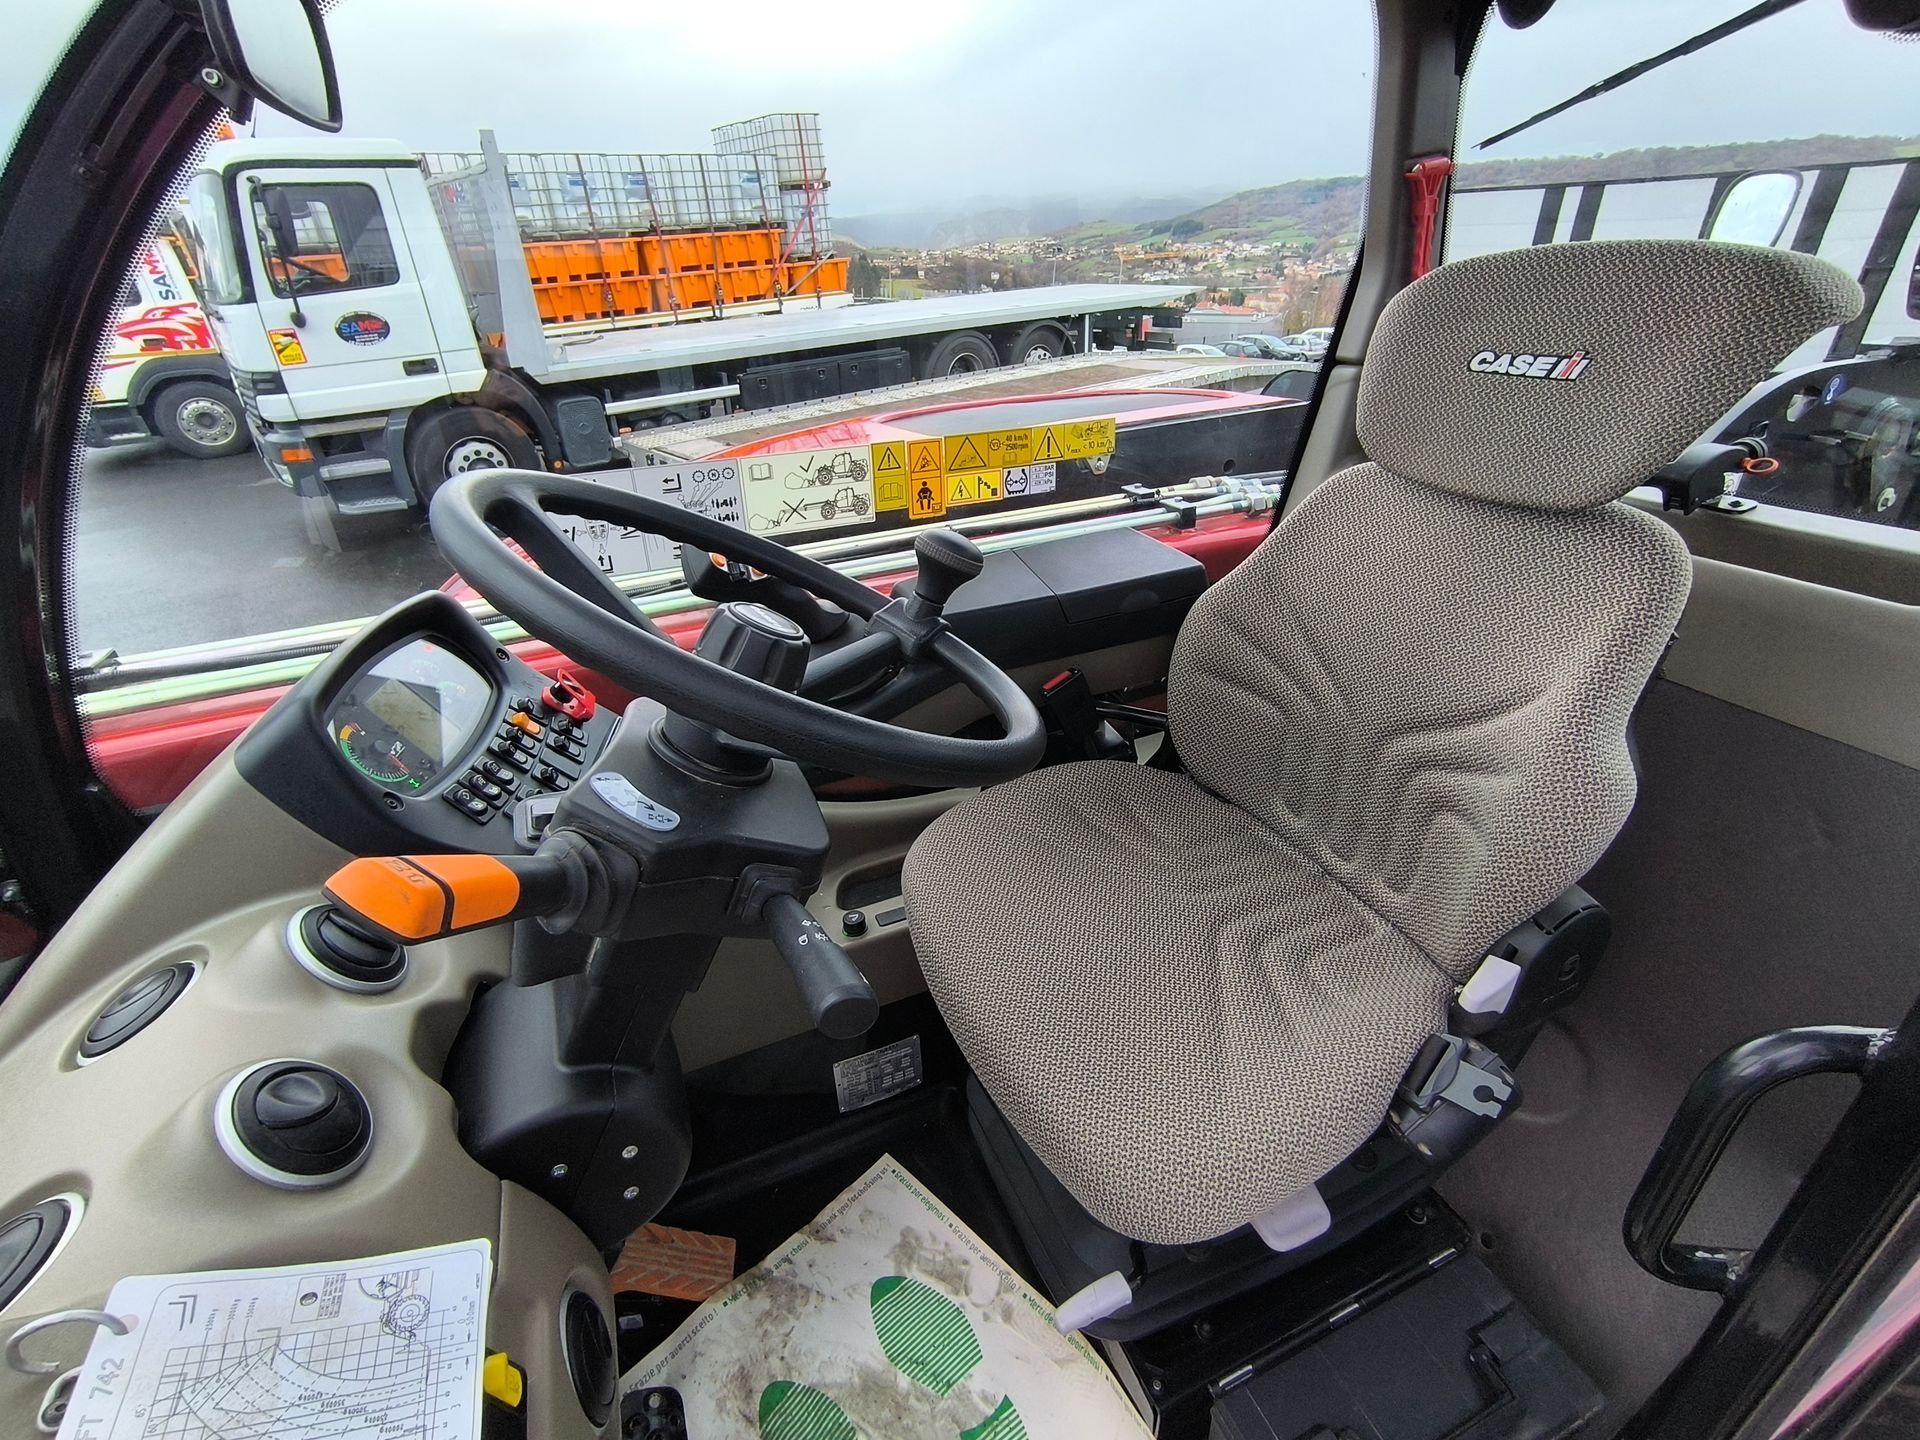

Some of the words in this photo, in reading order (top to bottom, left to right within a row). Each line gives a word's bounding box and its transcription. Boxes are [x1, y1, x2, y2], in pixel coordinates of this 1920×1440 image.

[1469, 351, 1559, 378] CASE
[1088, 441, 1095, 449] 10
[895, 1171, 913, 1190] Gracias
[911, 1188, 922, 1199] por
[952, 1226, 971, 1246] Grazie
[968, 1242, 981, 1255] per
[998, 1270, 1017, 1290] scelto
[655, 1356, 670, 1374] per
[691, 1313, 714, 1338] scelto
[89, 1358, 125, 1399] 742
